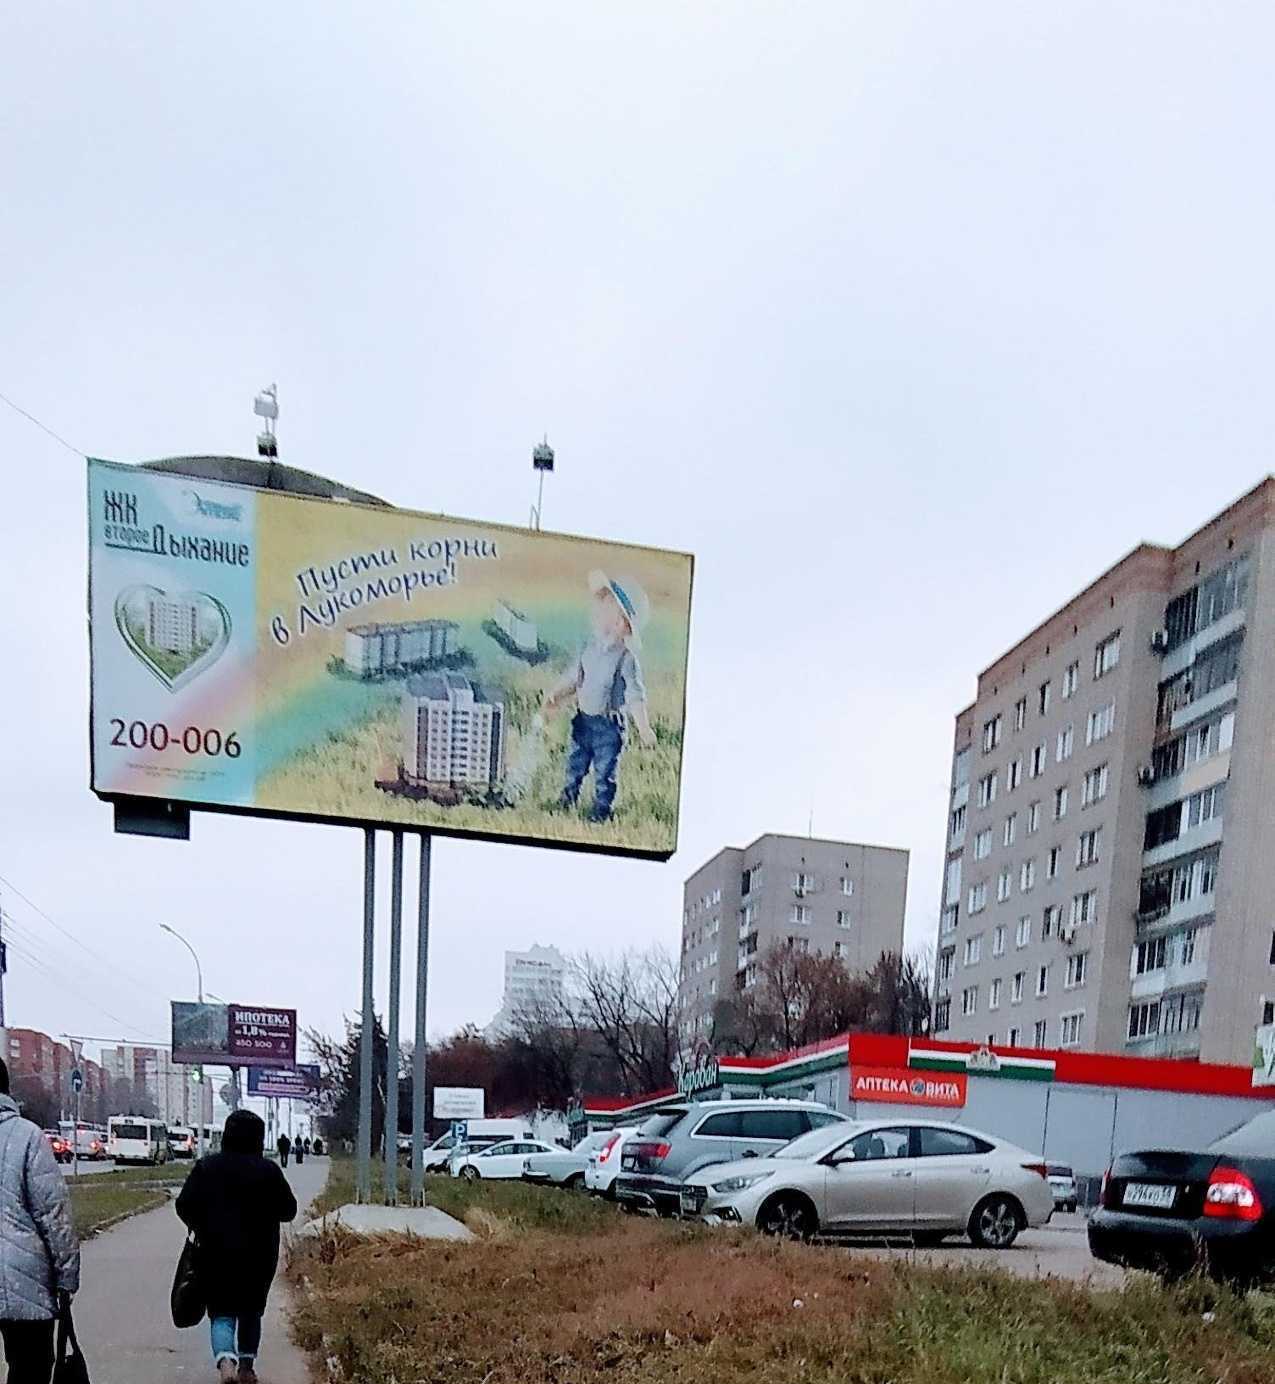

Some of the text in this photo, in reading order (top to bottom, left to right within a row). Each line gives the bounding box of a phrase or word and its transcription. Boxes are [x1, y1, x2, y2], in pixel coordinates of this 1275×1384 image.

[103, 489, 138, 527] ЖК
[103, 524, 250, 567] второе Дыхание
[295, 537, 498, 598] Пусти корни
[271, 561, 457, 646] в Лукоморье!
[109, 718, 242, 759] 200-006
[234, 1011, 290, 1025] ИПОТЕКА
[856, 1076, 960, 1098] АПТЕКА ВИТА
